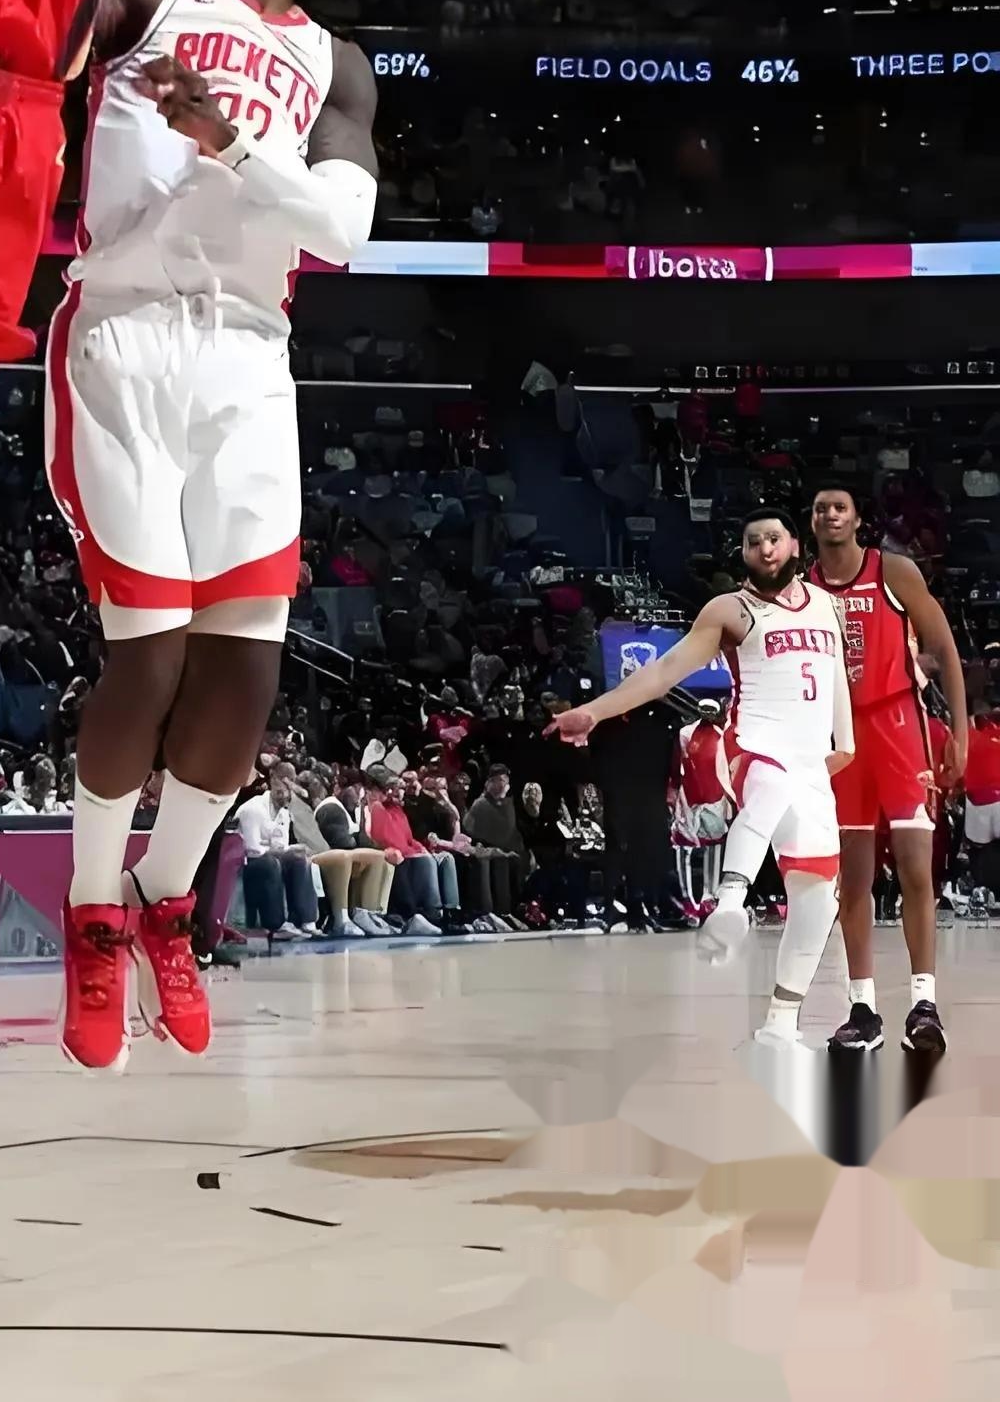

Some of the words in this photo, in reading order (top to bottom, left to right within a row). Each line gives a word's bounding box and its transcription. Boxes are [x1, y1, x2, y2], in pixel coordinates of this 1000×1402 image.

[535, 57, 611, 79] FIELD
[741, 58, 800, 83] 46%
[850, 53, 945, 78] THREE
[953, 51, 1000, 73] PO
[174, 32, 321, 136] ROCKETS
[801, 661, 817, 701] 5
